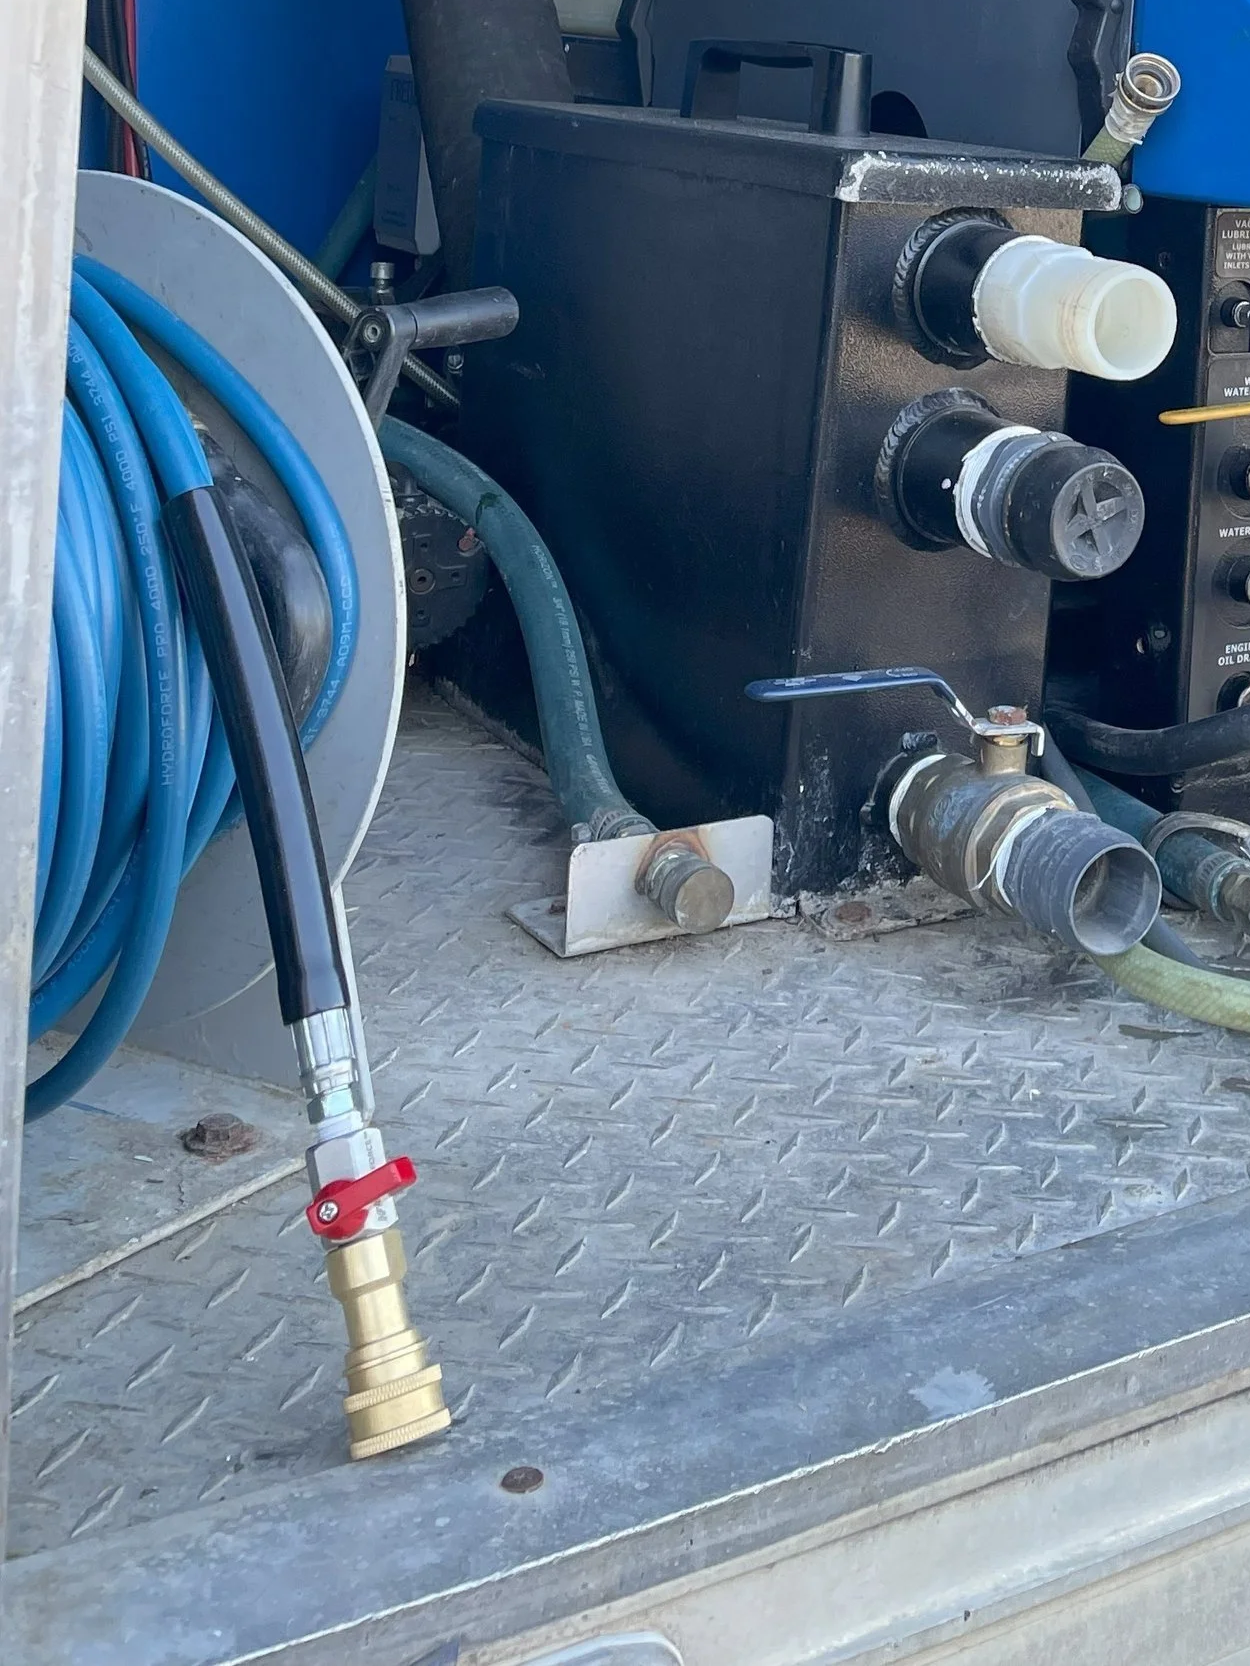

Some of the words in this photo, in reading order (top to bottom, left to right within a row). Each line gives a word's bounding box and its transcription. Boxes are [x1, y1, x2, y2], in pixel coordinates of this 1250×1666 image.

[1223, 261, 1250, 270] INLETS
[1225, 252, 1247, 260] WITH
[81, 370, 105, 407] 3744
[102, 414, 119, 444] PSI
[115, 452, 137, 492] 4000
[145, 565, 161, 611] 4000
[154, 622, 168, 658] PRO
[1218, 655, 1235, 666] OIL
[317, 679, 340, 720] 3744
[159, 669, 175, 786] HYDROFORCE
